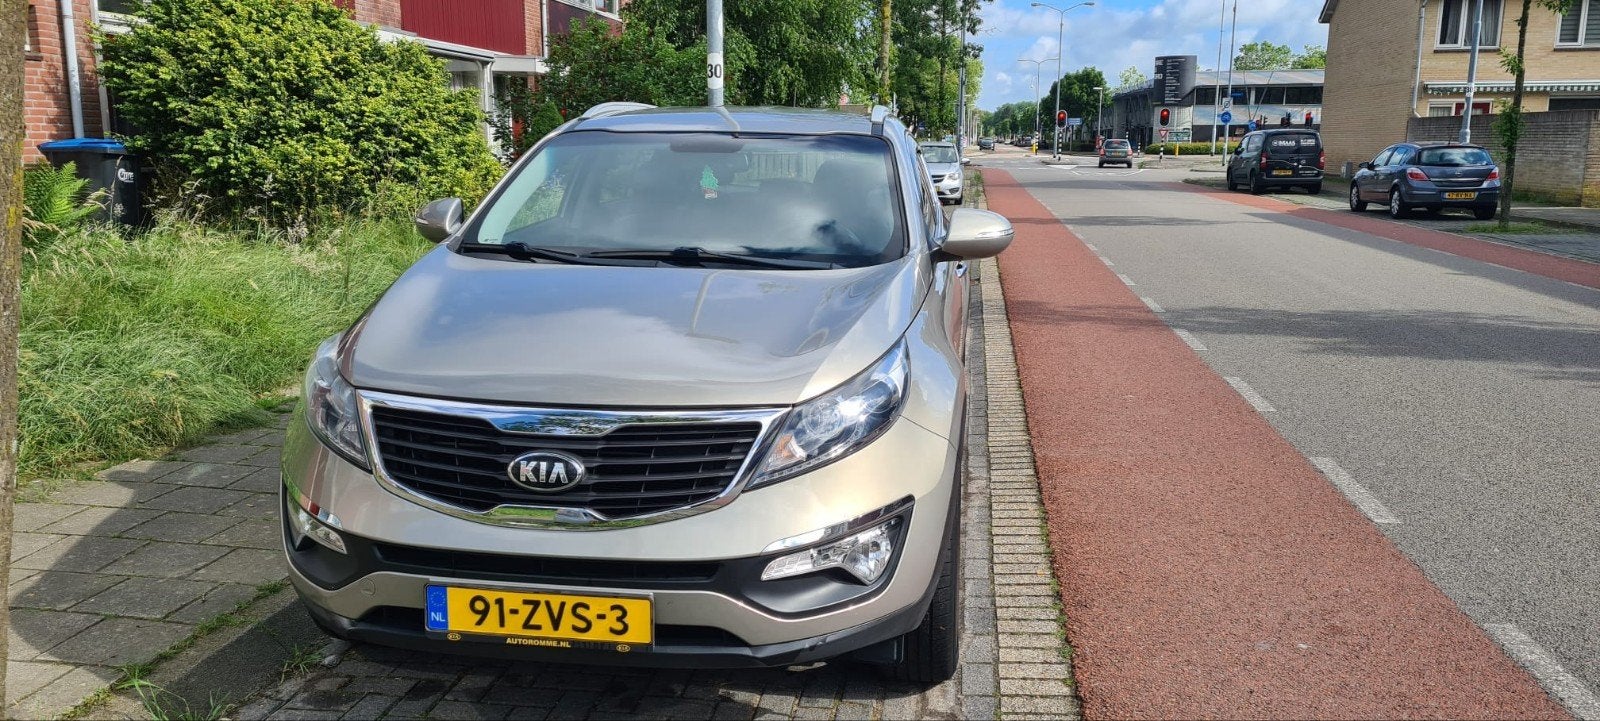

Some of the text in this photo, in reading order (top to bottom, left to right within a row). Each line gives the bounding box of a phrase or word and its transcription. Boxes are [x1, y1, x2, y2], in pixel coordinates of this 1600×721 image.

[707, 63, 722, 79] 30
[519, 460, 569, 484] KIA
[431, 612, 446, 622] NL
[468, 594, 630, 636] 91-ZVS-3
[506, 637, 571, 648] AUTOROMME.NL
